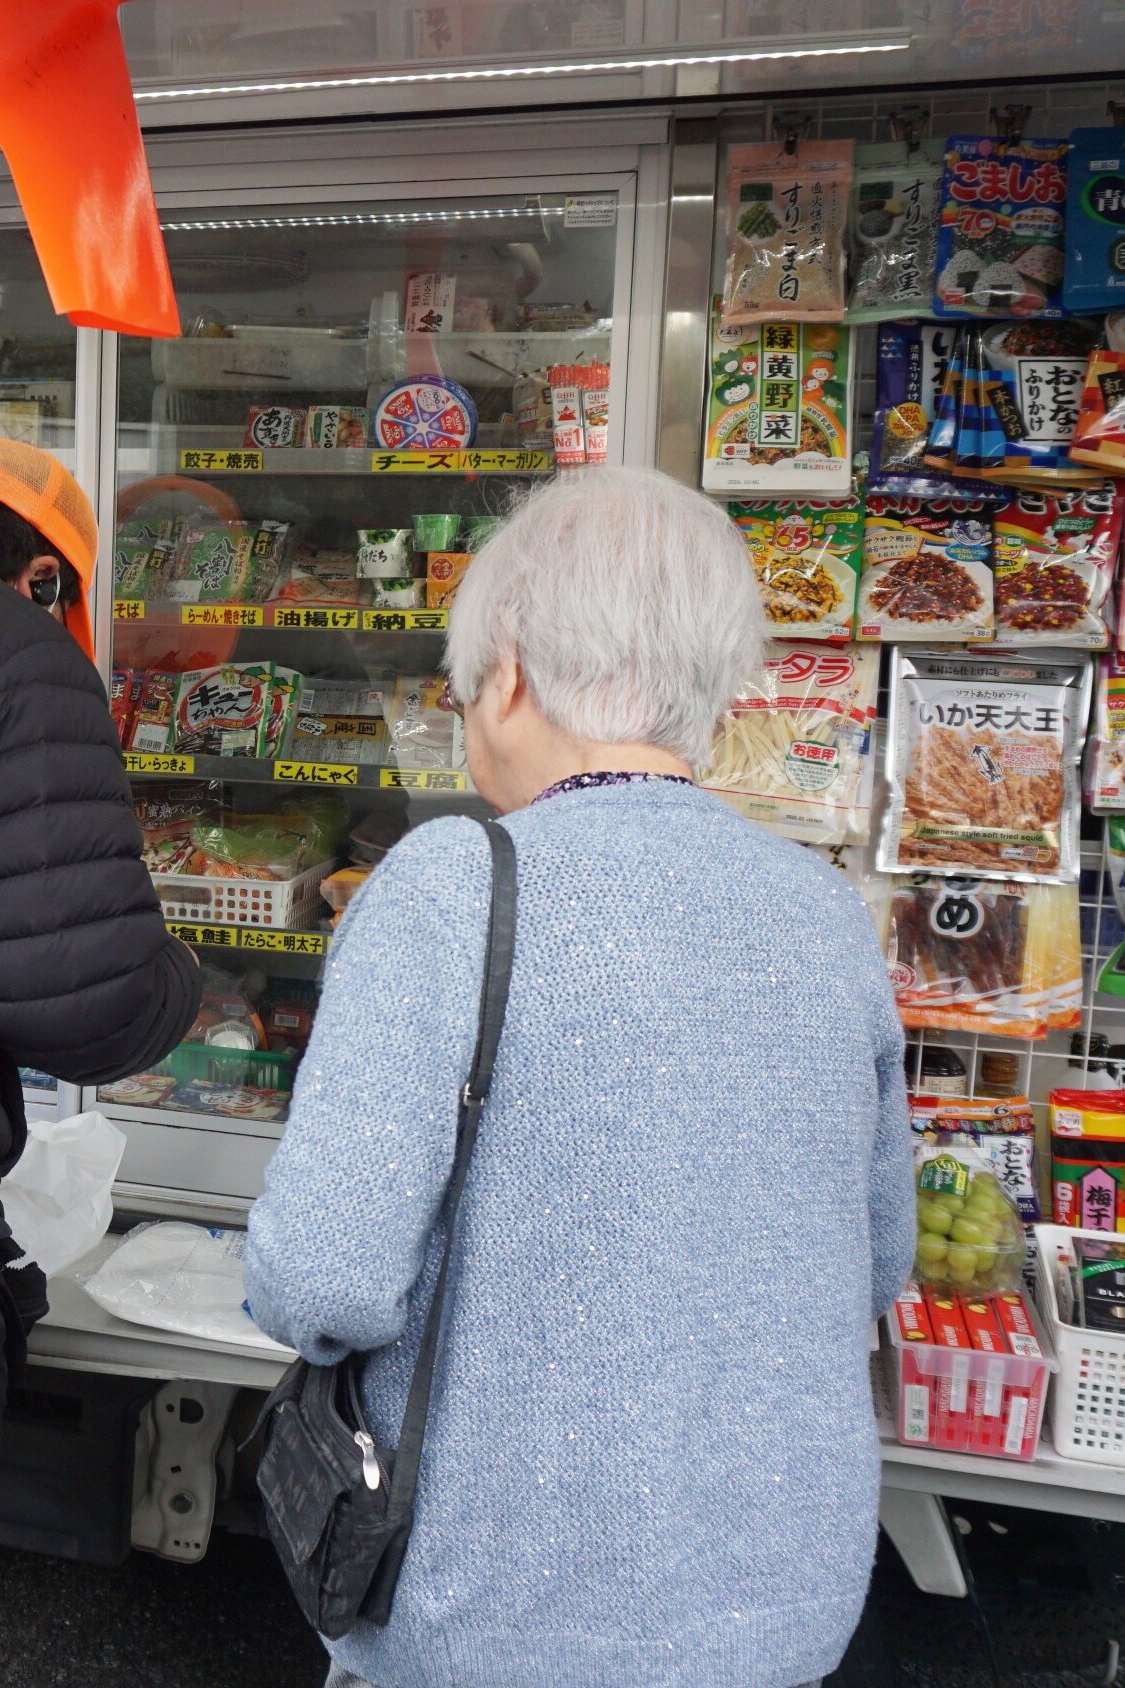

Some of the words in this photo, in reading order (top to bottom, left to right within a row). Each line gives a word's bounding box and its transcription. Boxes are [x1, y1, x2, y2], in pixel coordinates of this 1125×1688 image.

[950, 159, 1068, 203] ごましお
[1097, 188, 1125, 212] 青
[779, 182, 805, 301] すりごま白
[894, 178, 925, 301] すりごま黒
[764, 326, 795, 440] 緑黄野菜
[899, 406, 921, 415] DHA
[1025, 369, 1046, 432] ふりかけ
[1045, 365, 1081, 434] おとなの
[994, 390, 1022, 436] 本かつお
[184, 451, 259, 470] 餃子・焼売
[376, 453, 454, 470] チーズ
[462, 452, 544, 470] バター・マーガリン
[776, 525, 810, 547] 65
[114, 602, 140, 619] そば
[188, 609, 257, 625] らーめん・焼きそば
[277, 610, 357, 627] 油揚げ
[372, 613, 445, 630] 納豆
[187, 684, 253, 707] キュー
[955, 689, 1027, 700] ソフトあたりめフライ
[191, 703, 253, 720] ちゃん
[919, 702, 1061, 733] いか天大王
[792, 743, 836, 763] お徳用
[278, 764, 355, 784] こんにゃく
[387, 771, 458, 789] 豆腐
[921, 826, 960, 837] Japanese
[961, 828, 981, 838] style
[982, 830, 998, 838] soft
[999, 831, 1019, 840] fried
[1021, 834, 1043, 843] squid
[244, 931, 323, 953] たらこ・明太子
[1056, 1182, 1073, 1225] 6袋入
[1086, 1185, 1112, 1231] 梅干
[1024, 1396, 1037, 1439] MACADAMIA
